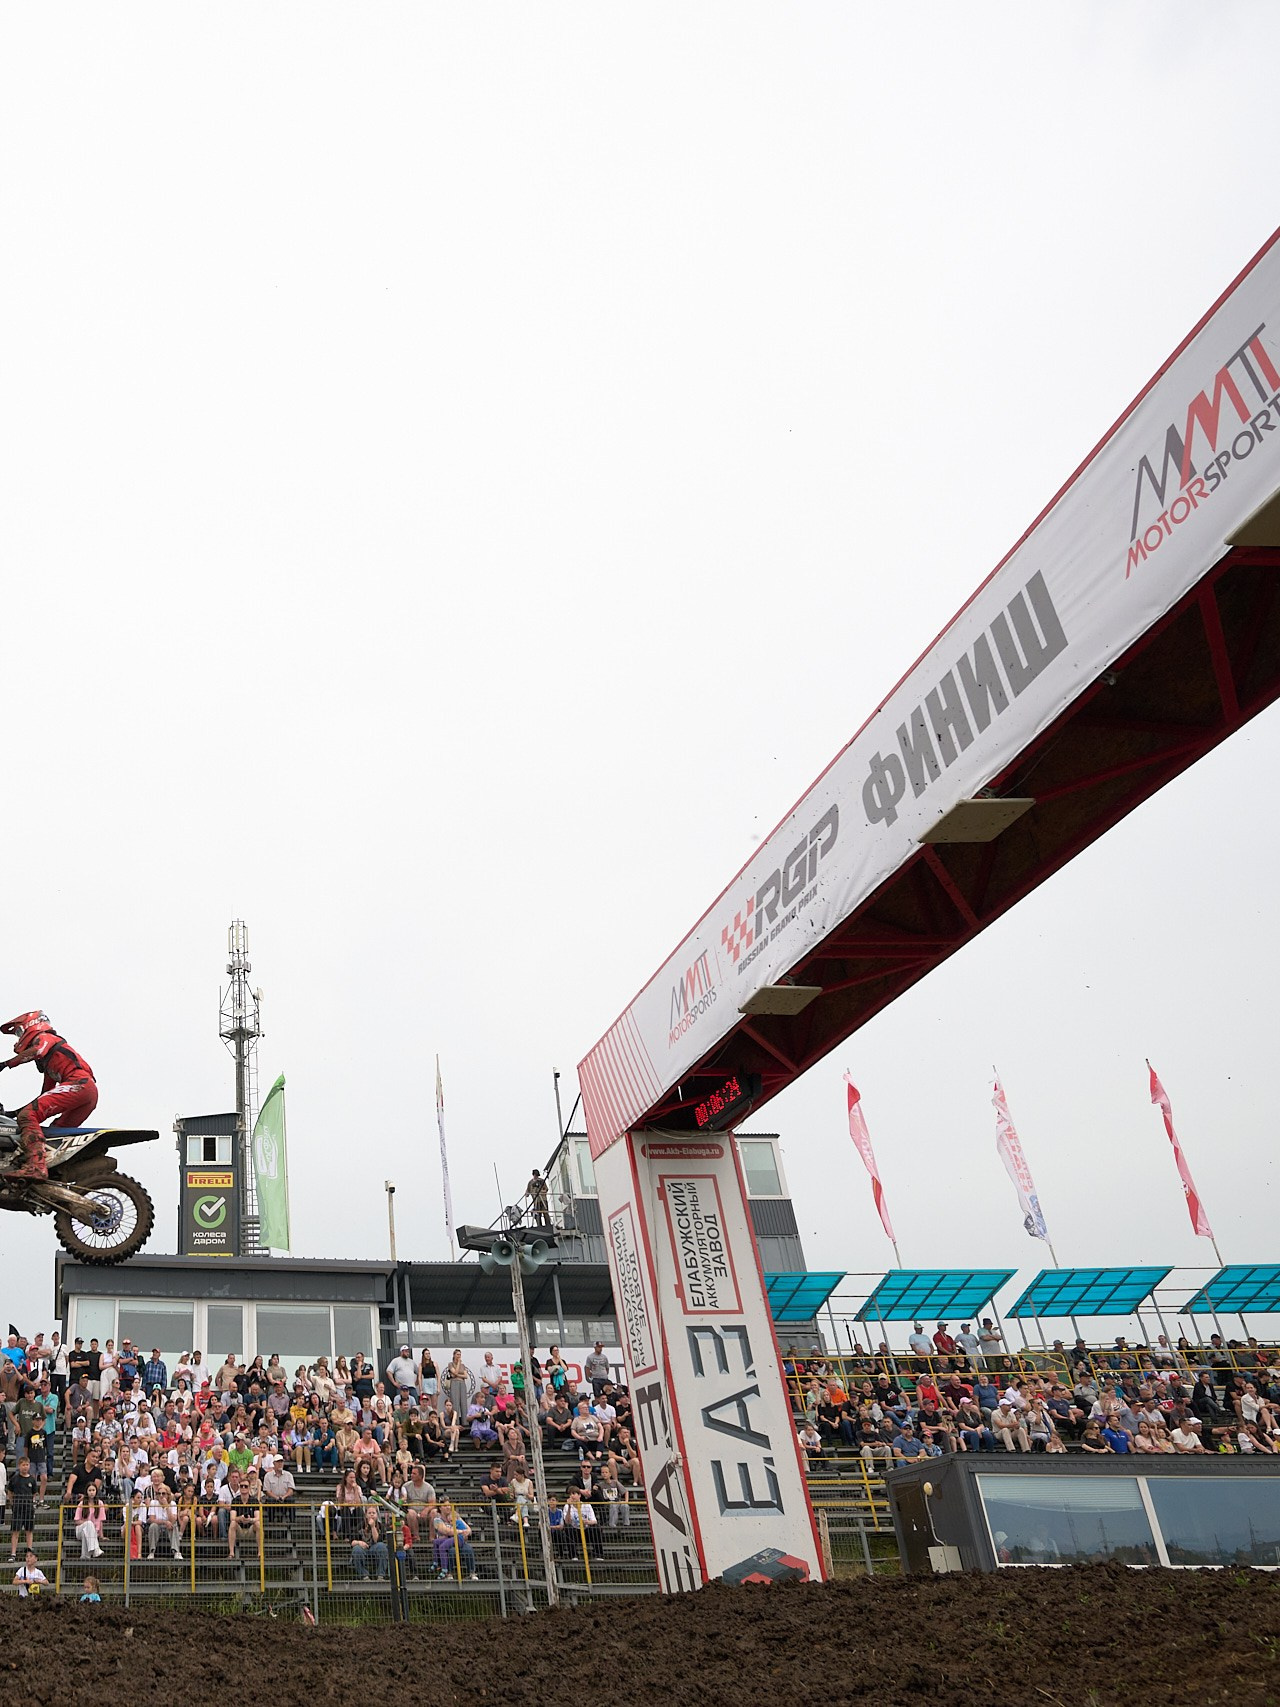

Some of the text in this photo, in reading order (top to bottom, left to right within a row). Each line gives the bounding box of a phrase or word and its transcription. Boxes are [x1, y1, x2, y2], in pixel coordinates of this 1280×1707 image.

[862, 569, 1068, 828] ФИНИШ
[754, 803, 839, 940] RGP
[737, 884, 818, 976] RUSSIAN GRAND PRIX
[668, 985, 718, 1050] MOTORSPORTS
[61, 1133, 95, 1151] 710
[694, 1077, 741, 1127] 00:06:24
[188, 1174, 232, 1184] PIRELLI
[668, 1182, 706, 1307] ЕЛАБУЖСКИЙ
[684, 1182, 720, 1309] АККУМУЛЯТОРНЫЙ
[704, 1213, 728, 1278] ЗАВОД
[611, 1220, 640, 1368] ЕЛАБУЖСКИЙ
[629, 1250, 647, 1328] ЗАВОД
